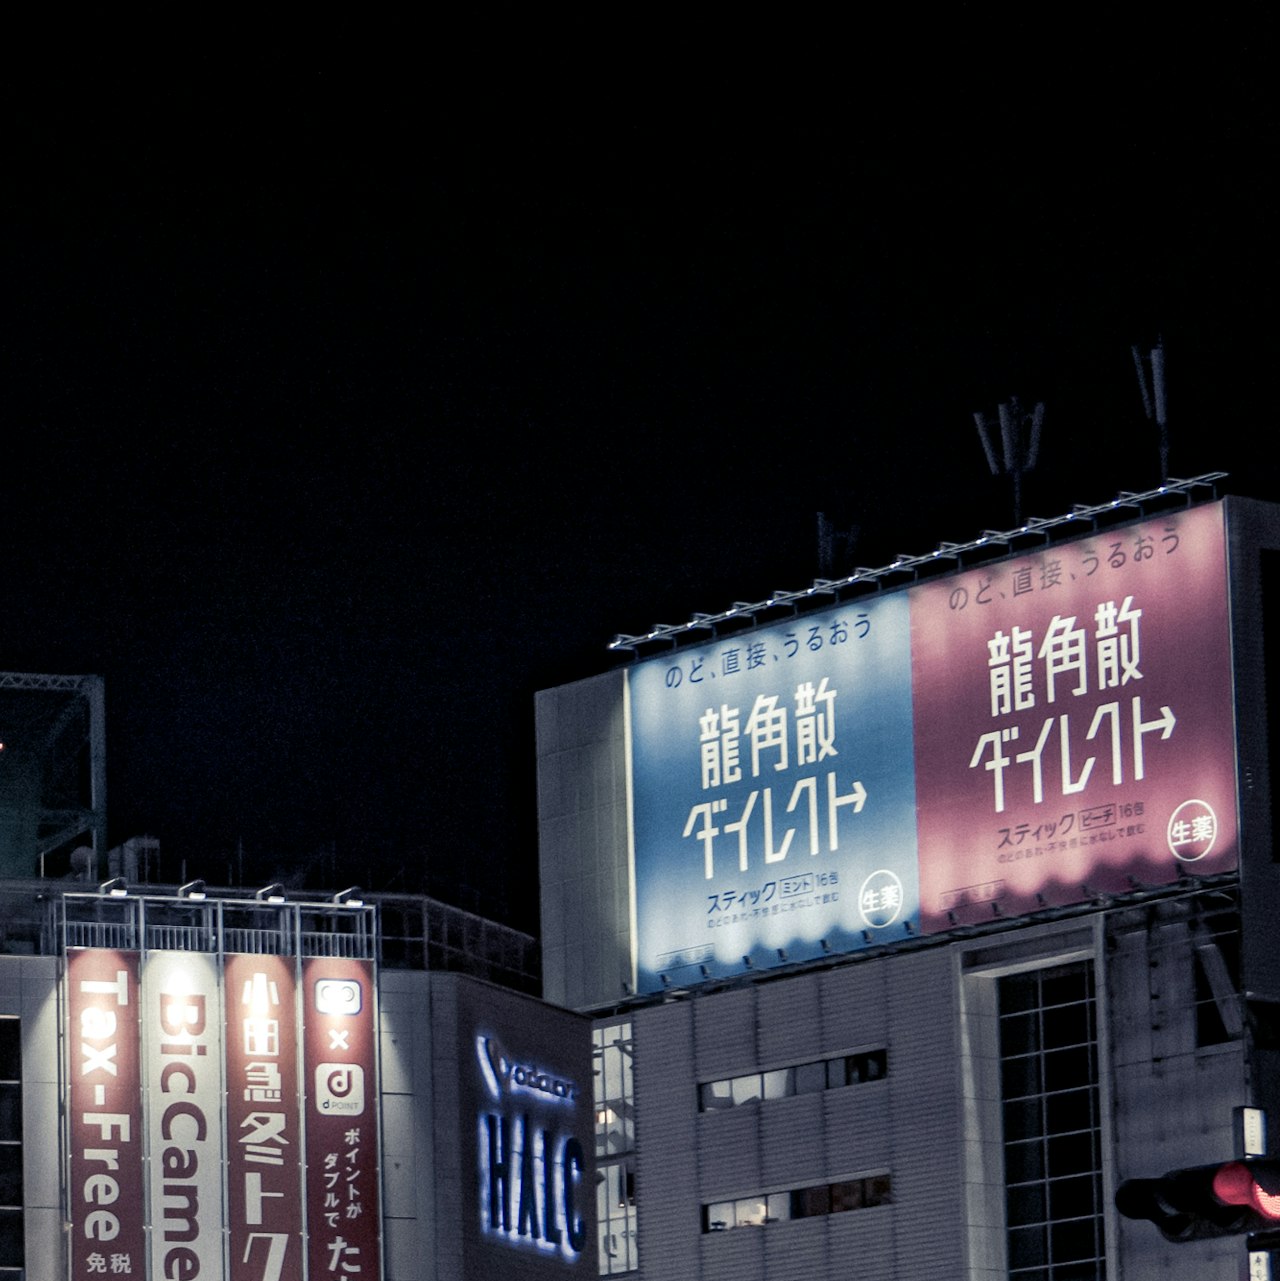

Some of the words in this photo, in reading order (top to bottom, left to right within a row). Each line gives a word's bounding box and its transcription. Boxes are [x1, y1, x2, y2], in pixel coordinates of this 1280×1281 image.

[949, 527, 1181, 611] のど、直接、うるおう
[664, 613, 872, 689] のど、直接、うるおう
[987, 596, 1143, 717] 龍角散
[698, 677, 839, 789] 龍角散
[968, 697, 1177, 813] ダイレクト
[681, 771, 868, 880] ダイレクト
[997, 813, 1074, 849] スティック
[1171, 814, 1214, 846] 生薬
[707, 881, 777, 914] スティック
[862, 884, 900, 913] 生薬
[80, 970, 131, 1242] Tax-Free
[344, 1128, 362, 1219] ポイントが
[480, 1112, 586, 1257] HALC
[86, 1252, 132, 1274] 免税
